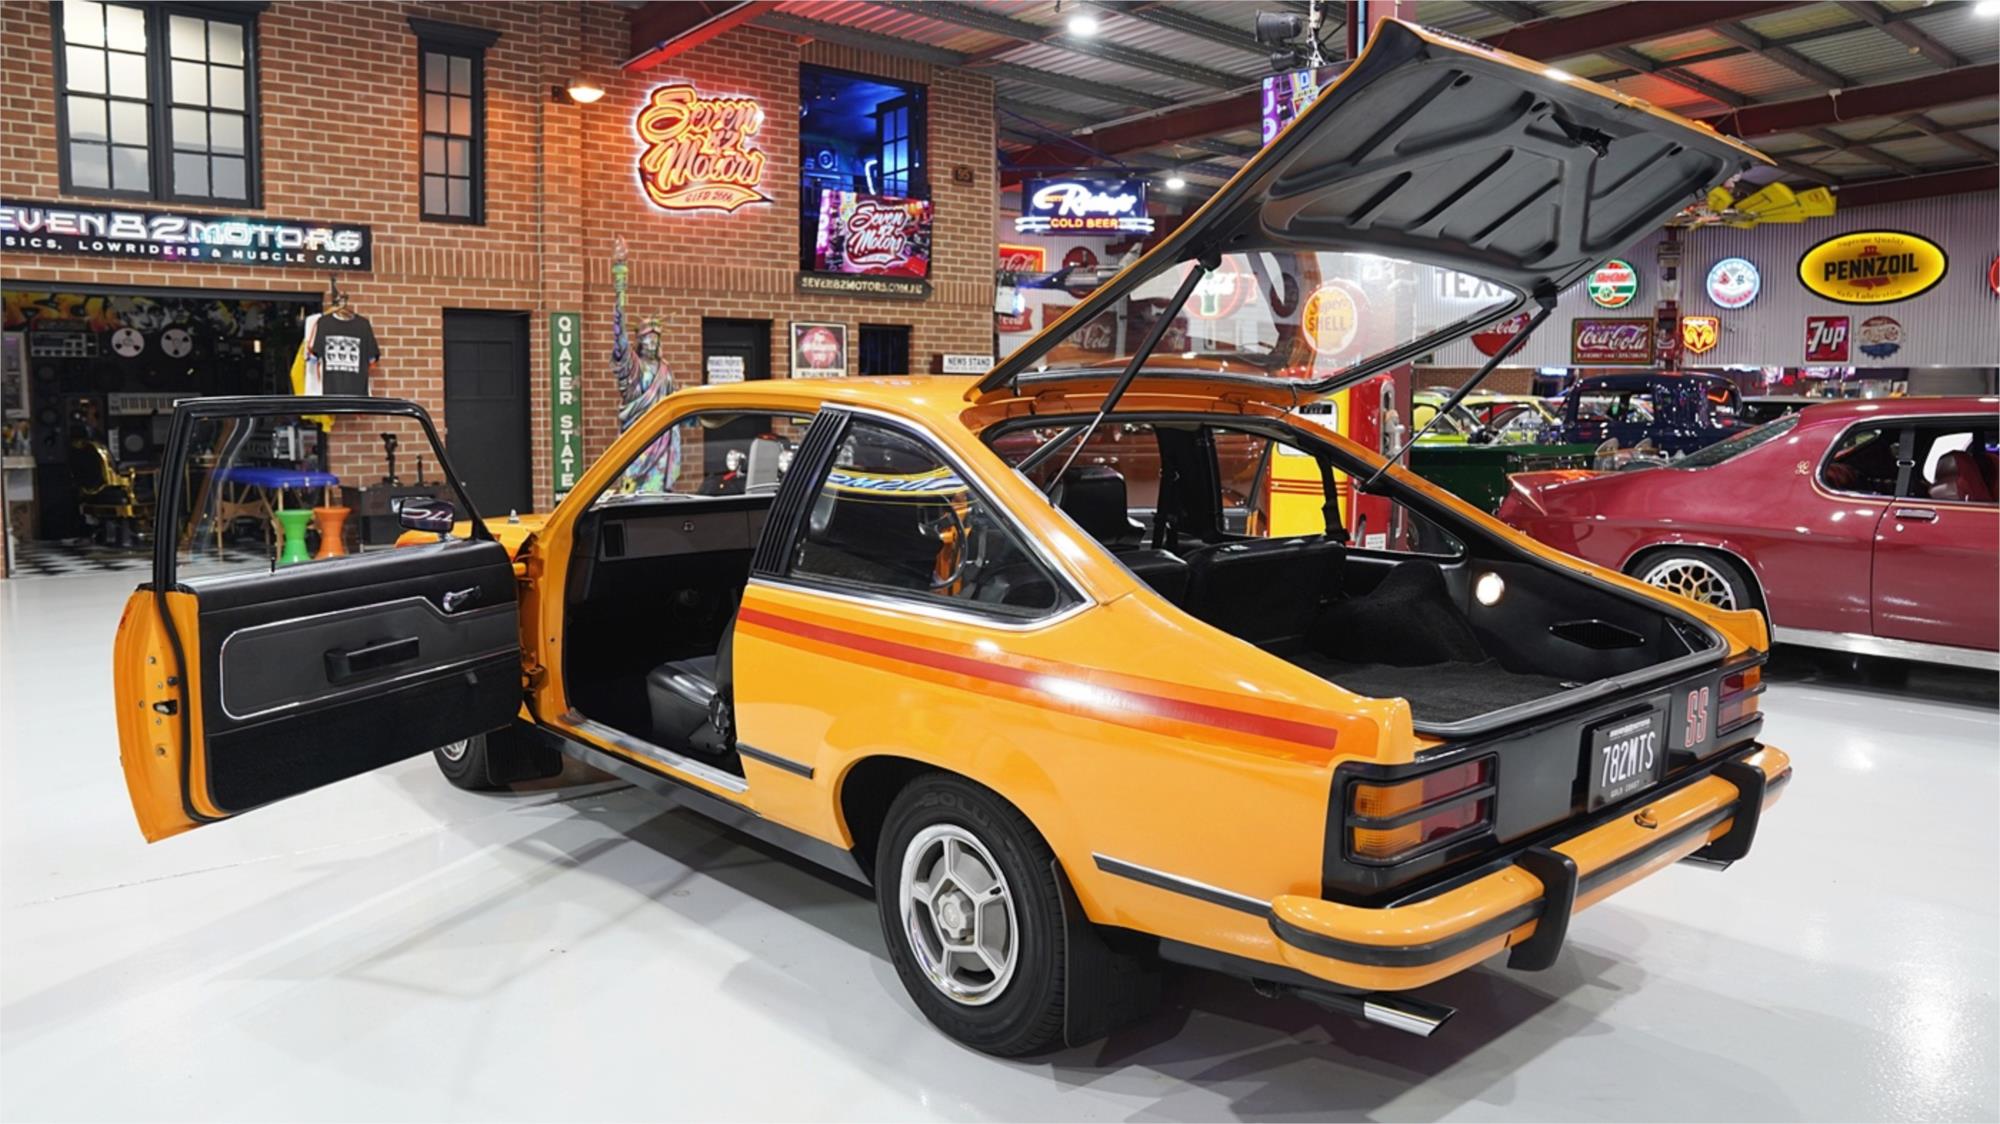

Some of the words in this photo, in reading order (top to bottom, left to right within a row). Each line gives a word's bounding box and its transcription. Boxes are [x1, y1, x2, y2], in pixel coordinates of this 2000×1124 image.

[640, 86, 760, 143] Seven
[711, 130, 738, 150] 82
[644, 137, 765, 190] Motors
[850, 204, 903, 232] Seven
[1050, 218, 1083, 228] COLD
[1086, 219, 1118, 229] BEER
[78, 240, 199, 256] LOWRIDERS
[211, 248, 221, 258] &
[233, 250, 306, 262] MUSCLE
[316, 255, 361, 265] CARS
[1824, 253, 1918, 281] PENNZOIL
[1309, 316, 1347, 331] SHELL
[1808, 321, 1846, 352] 7up
[558, 316, 572, 405] QUAKER
[948, 357, 967, 366] NEWS
[969, 357, 990, 366] STAND
[560, 415, 574, 487] STATE
[1684, 686, 1709, 747] SS
[1602, 731, 1656, 787] 782MTS
